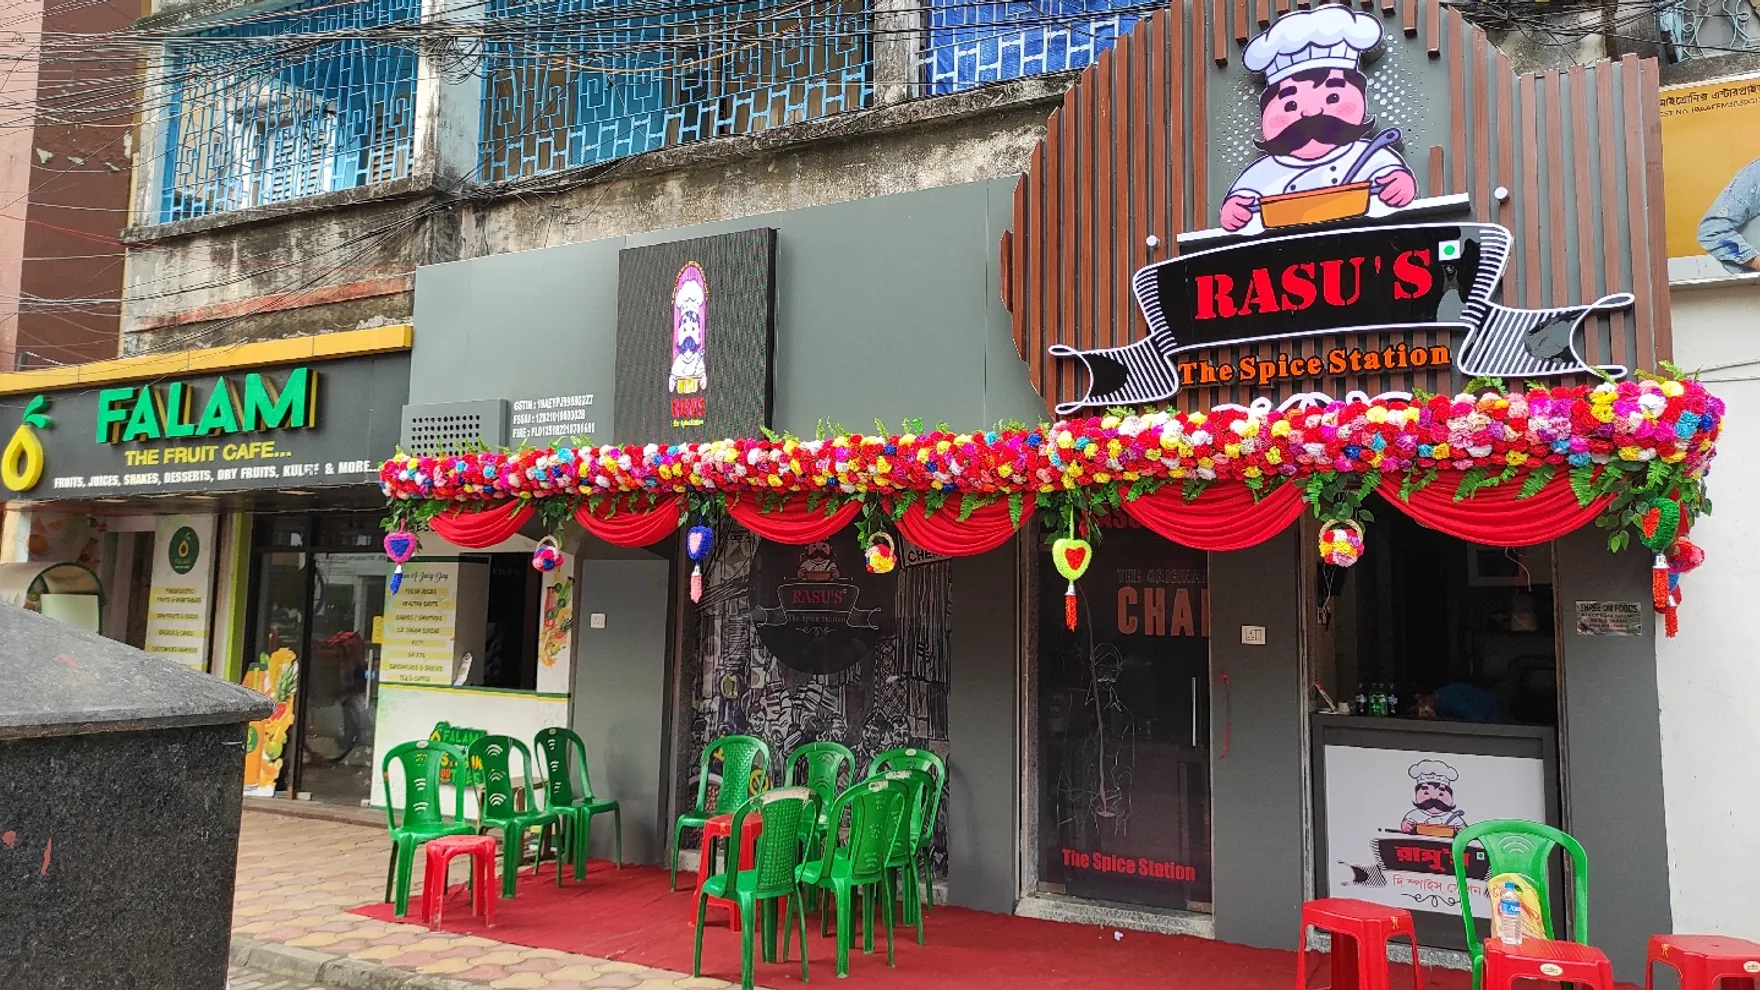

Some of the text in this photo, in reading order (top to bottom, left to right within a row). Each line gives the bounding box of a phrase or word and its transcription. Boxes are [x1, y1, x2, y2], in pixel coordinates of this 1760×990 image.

[1195, 249, 1433, 319] RASU'S
[1178, 343, 1451, 385] The Spice Station
[96, 366, 313, 443] FALAM
[124, 440, 291, 466] THE FRUIT CAFE...
[54, 476, 87, 489] FRUITS,
[88, 474, 121, 487] JUICES,
[124, 472, 161, 486] SHAKES,
[163, 470, 214, 483] DESSERTS,
[217, 468, 237, 481] DRY
[240, 466, 279, 479] FRUITS,
[325, 463, 334, 475] &
[791, 589, 844, 604] RASU'S
[1062, 848, 1197, 882] The Spice Station
